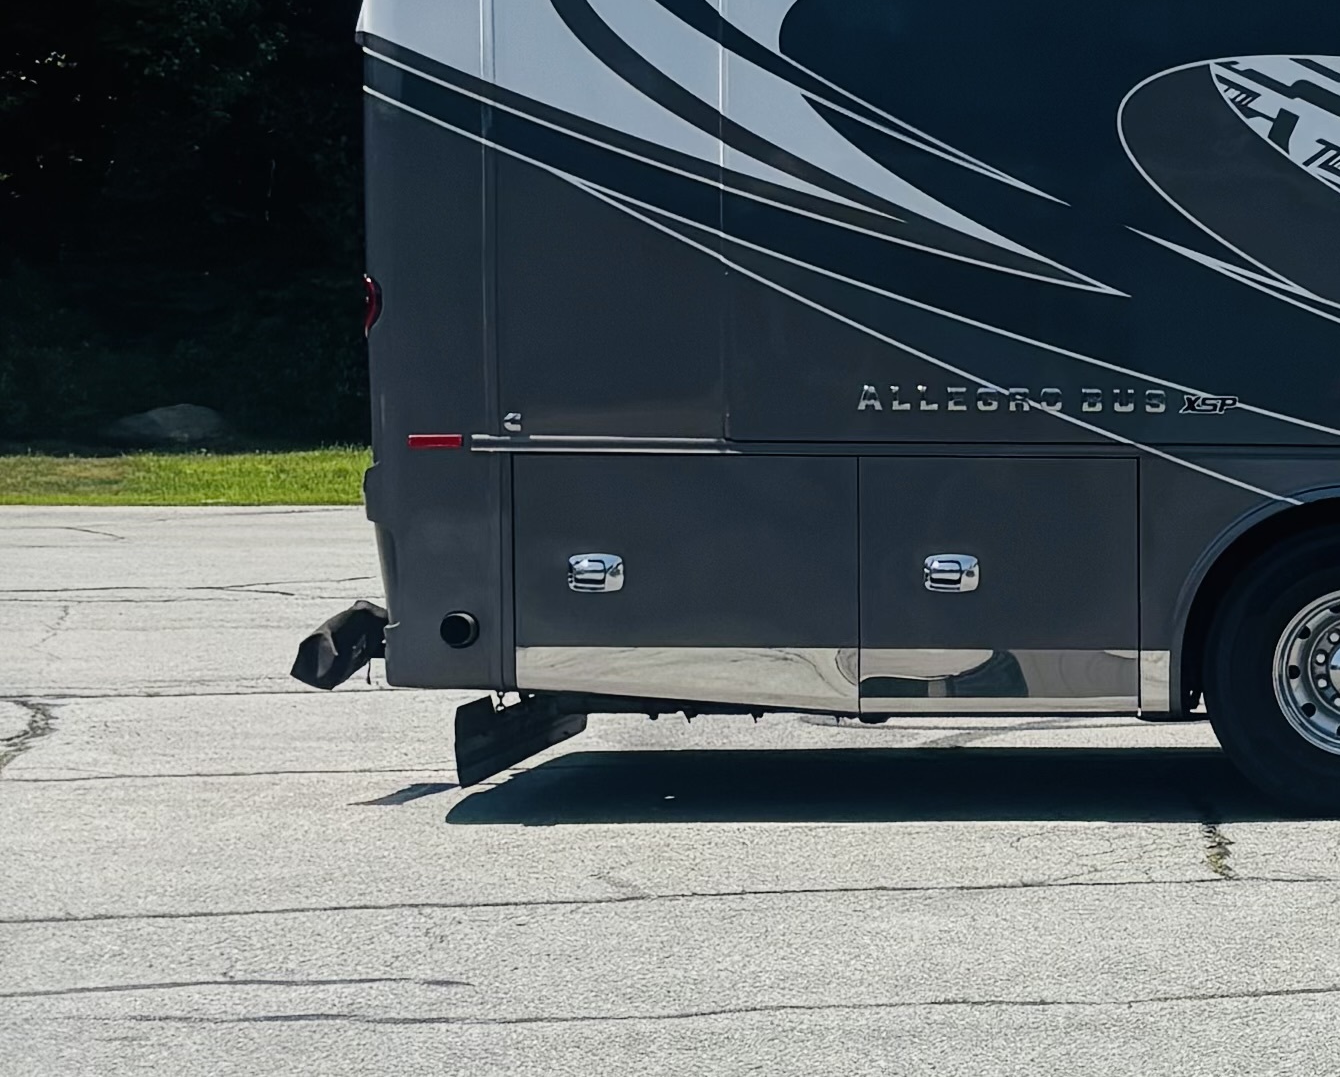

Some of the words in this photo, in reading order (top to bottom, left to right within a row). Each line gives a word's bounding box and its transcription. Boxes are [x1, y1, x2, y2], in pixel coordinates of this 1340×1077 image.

[857, 384, 1063, 411] ALLEGRO
[1081, 388, 1166, 413] BUS
[1179, 395, 1238, 414] XSP
